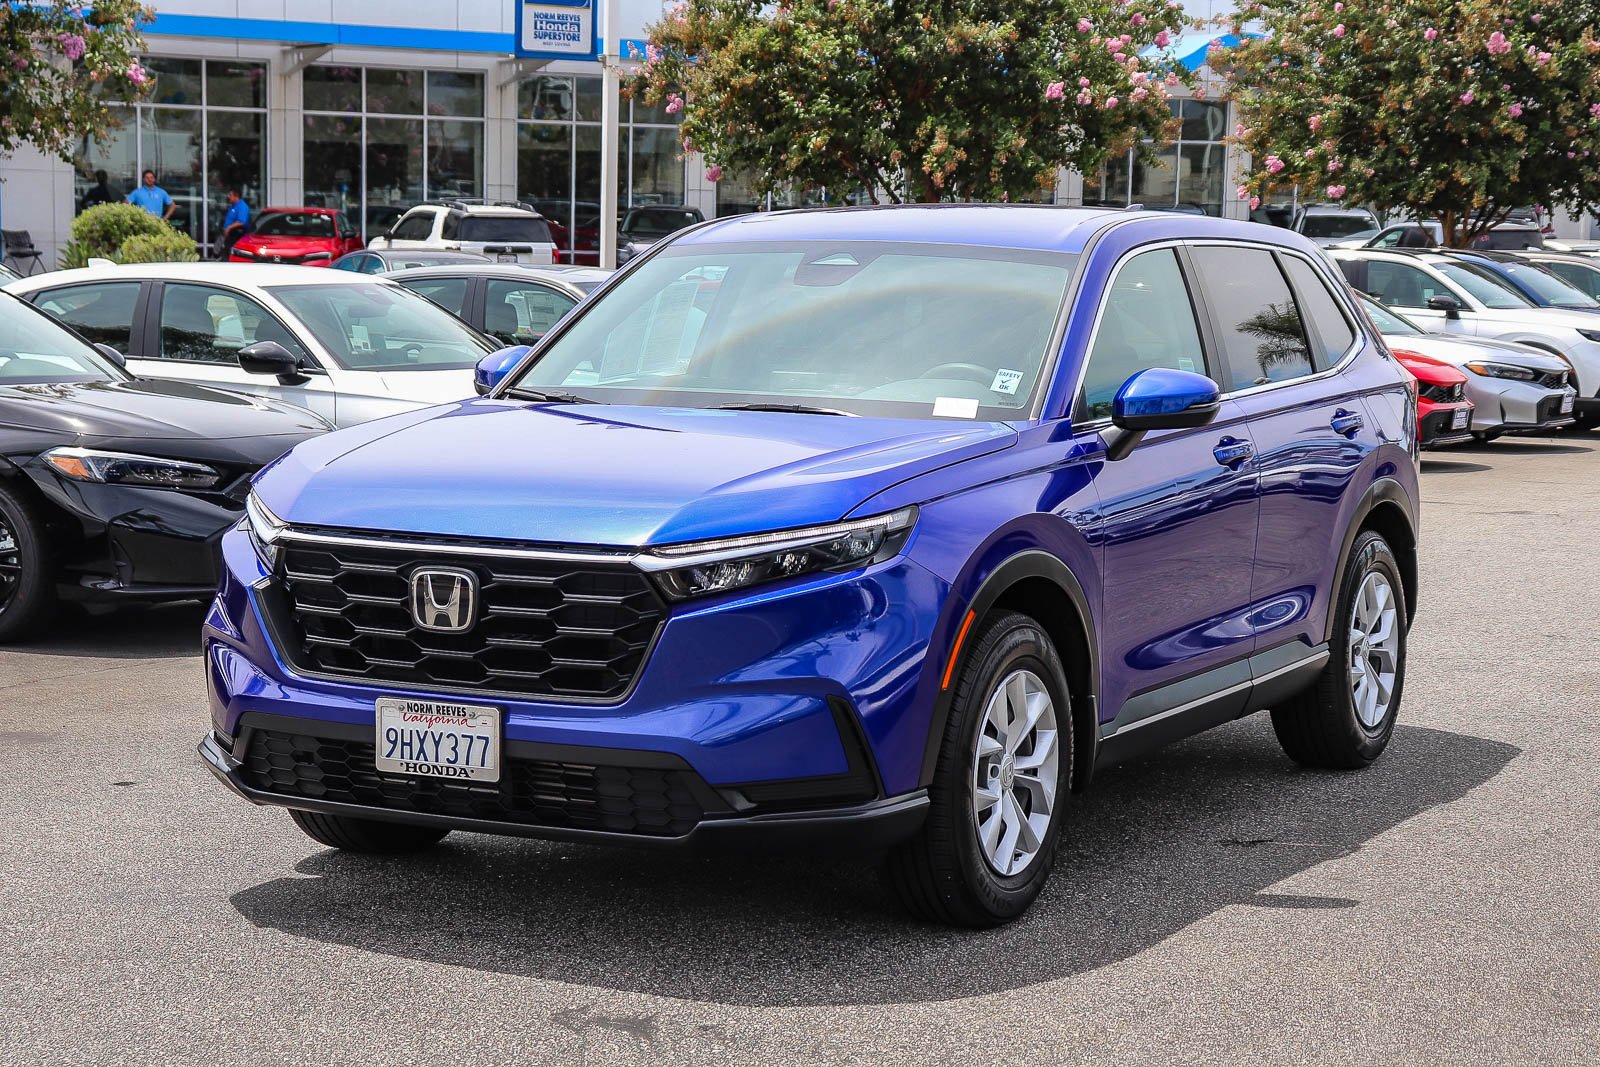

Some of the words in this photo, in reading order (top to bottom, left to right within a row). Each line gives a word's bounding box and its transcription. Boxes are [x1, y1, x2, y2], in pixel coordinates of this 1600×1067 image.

[534, 12, 556, 20] NORM
[557, 13, 580, 21] REEVES
[536, 20, 578, 31] Honda
[534, 31, 580, 42] SUPERSTORE
[998, 371, 1021, 379] SAFETY
[406, 702, 433, 714] NORM
[436, 705, 467, 718] REEVES
[402, 712, 476, 729] California
[385, 727, 490, 768] 9HXY377
[404, 762, 472, 779] HONDA
